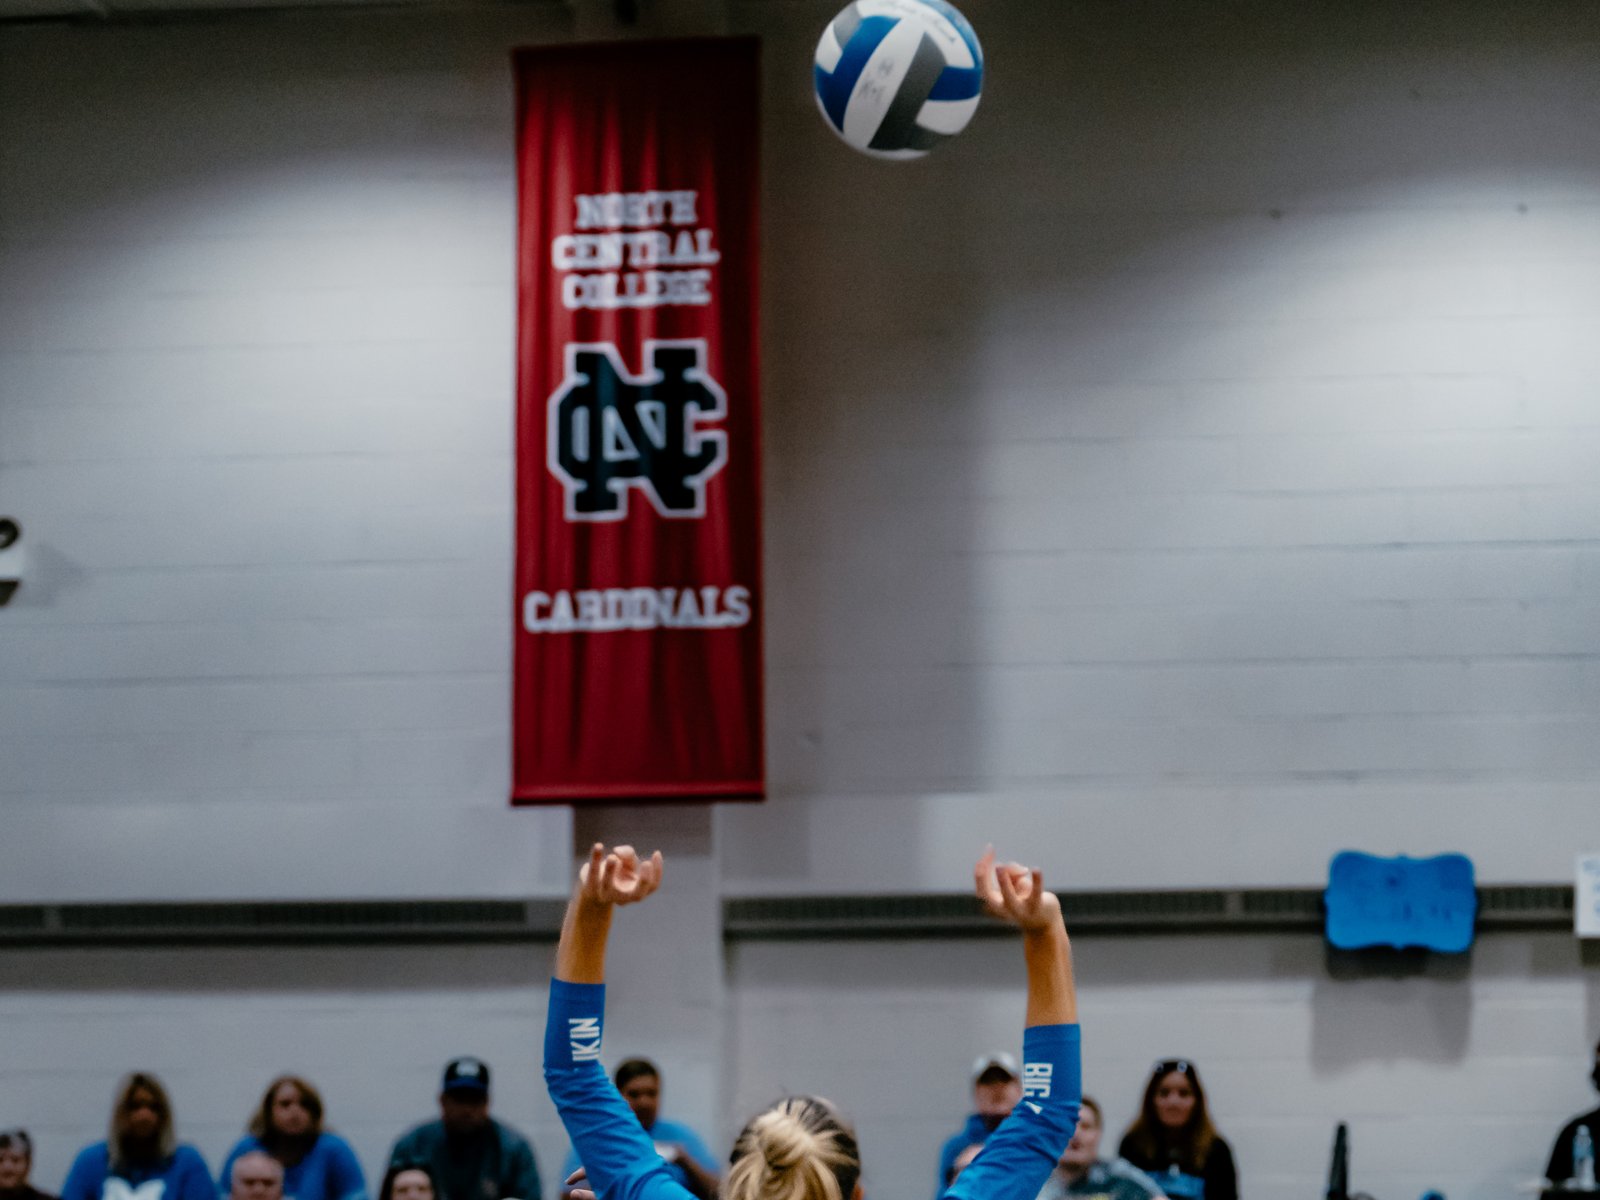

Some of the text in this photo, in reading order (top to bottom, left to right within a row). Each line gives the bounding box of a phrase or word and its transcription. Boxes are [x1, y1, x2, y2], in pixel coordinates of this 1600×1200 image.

[575, 190, 697, 228] NORTH
[552, 229, 720, 271] CENTRAL
[562, 269, 712, 309] COLLEGE
[523, 585, 751, 633] CARDINALS
